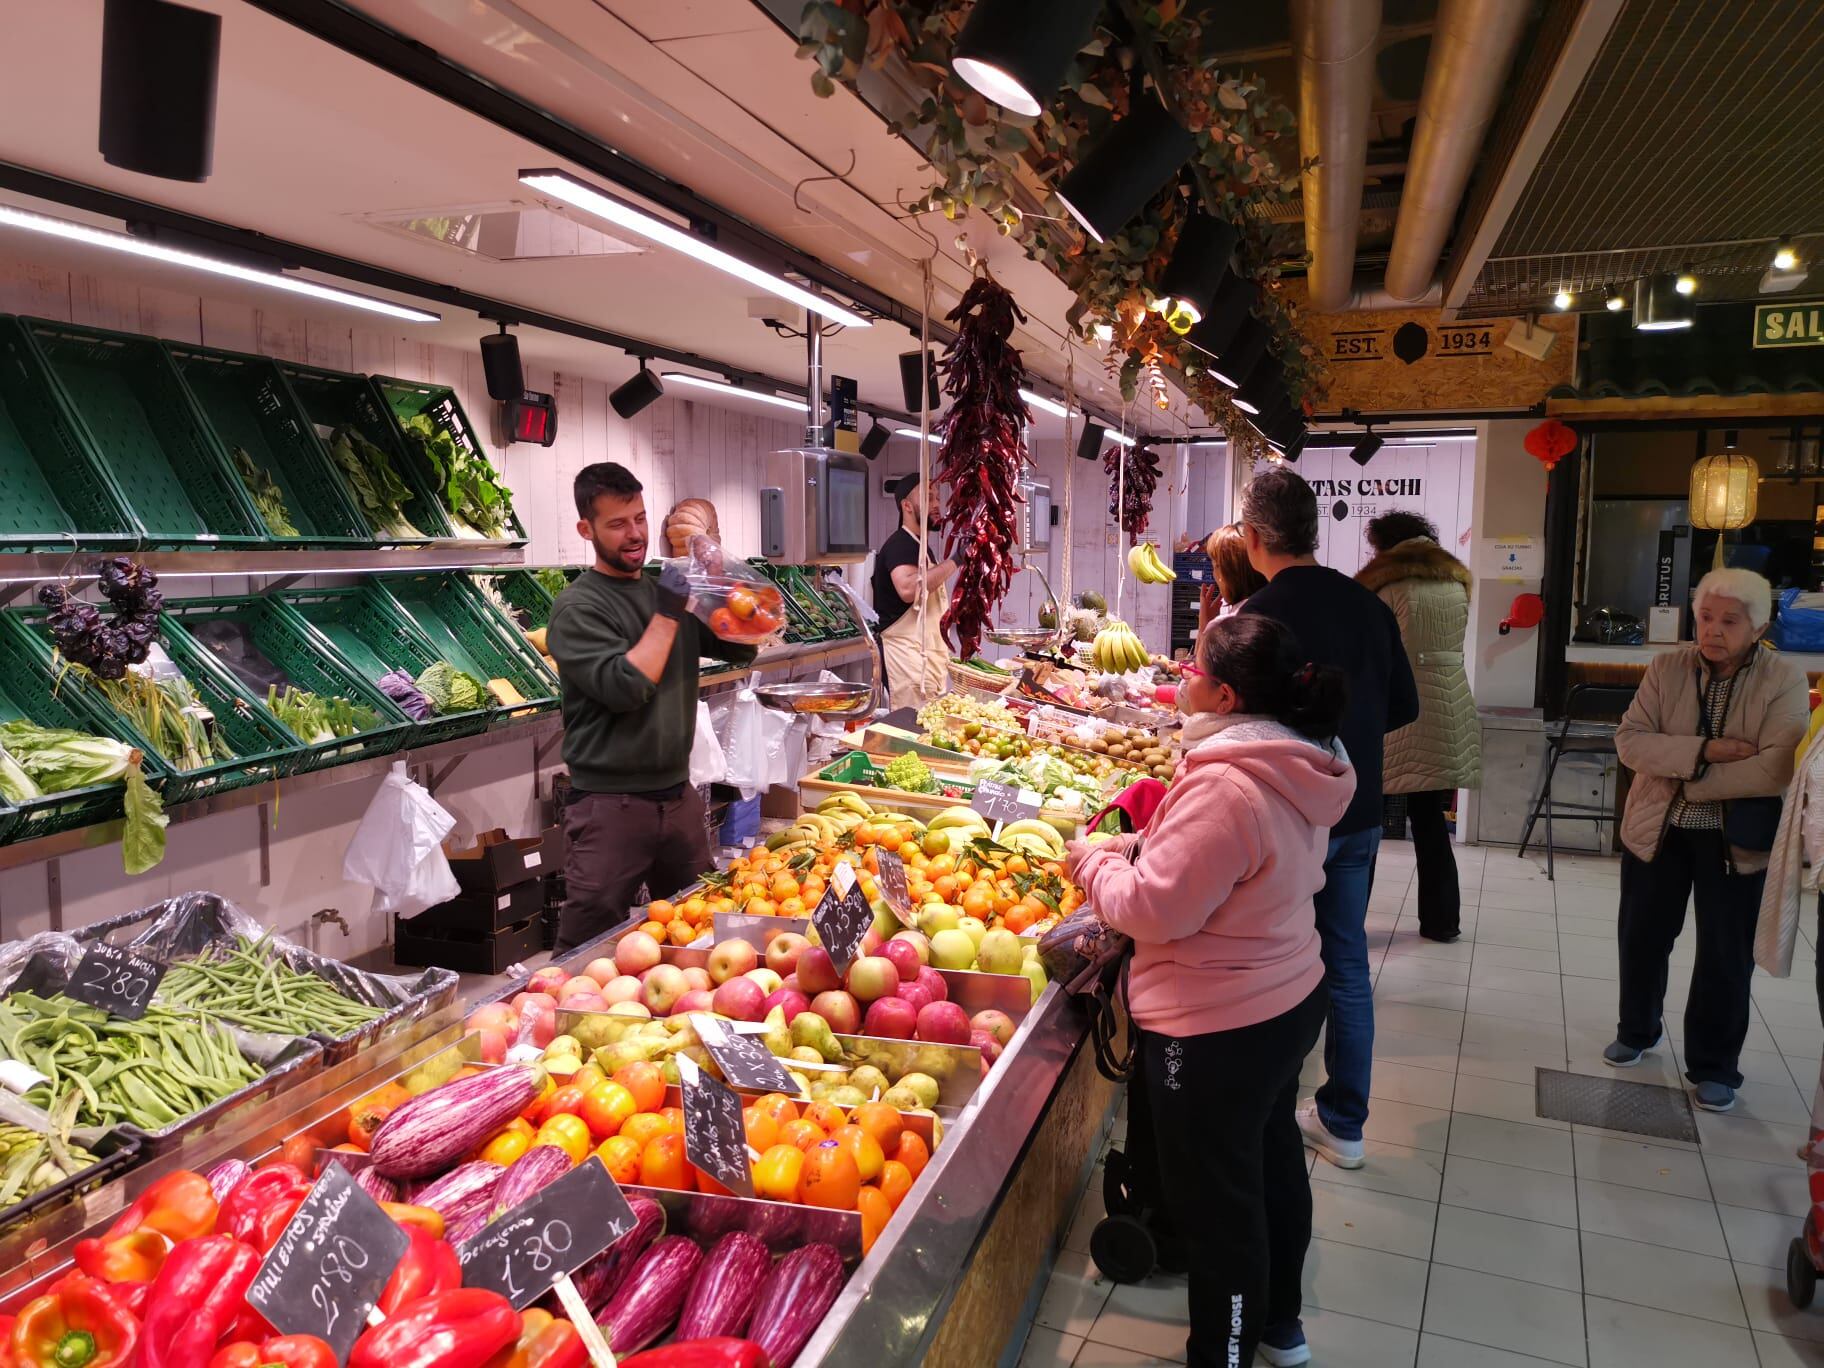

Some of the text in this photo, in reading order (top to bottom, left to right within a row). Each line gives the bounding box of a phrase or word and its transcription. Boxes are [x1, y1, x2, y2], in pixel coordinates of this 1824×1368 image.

[1335, 331, 1491, 355] EST. 1934
[1307, 479, 1422, 496] TAS CACHI
[1316, 506, 1376, 515] ST. 1934
[1659, 556, 1672, 608] BRUTUS
[1230, 1294, 1243, 1335] MOUSE
